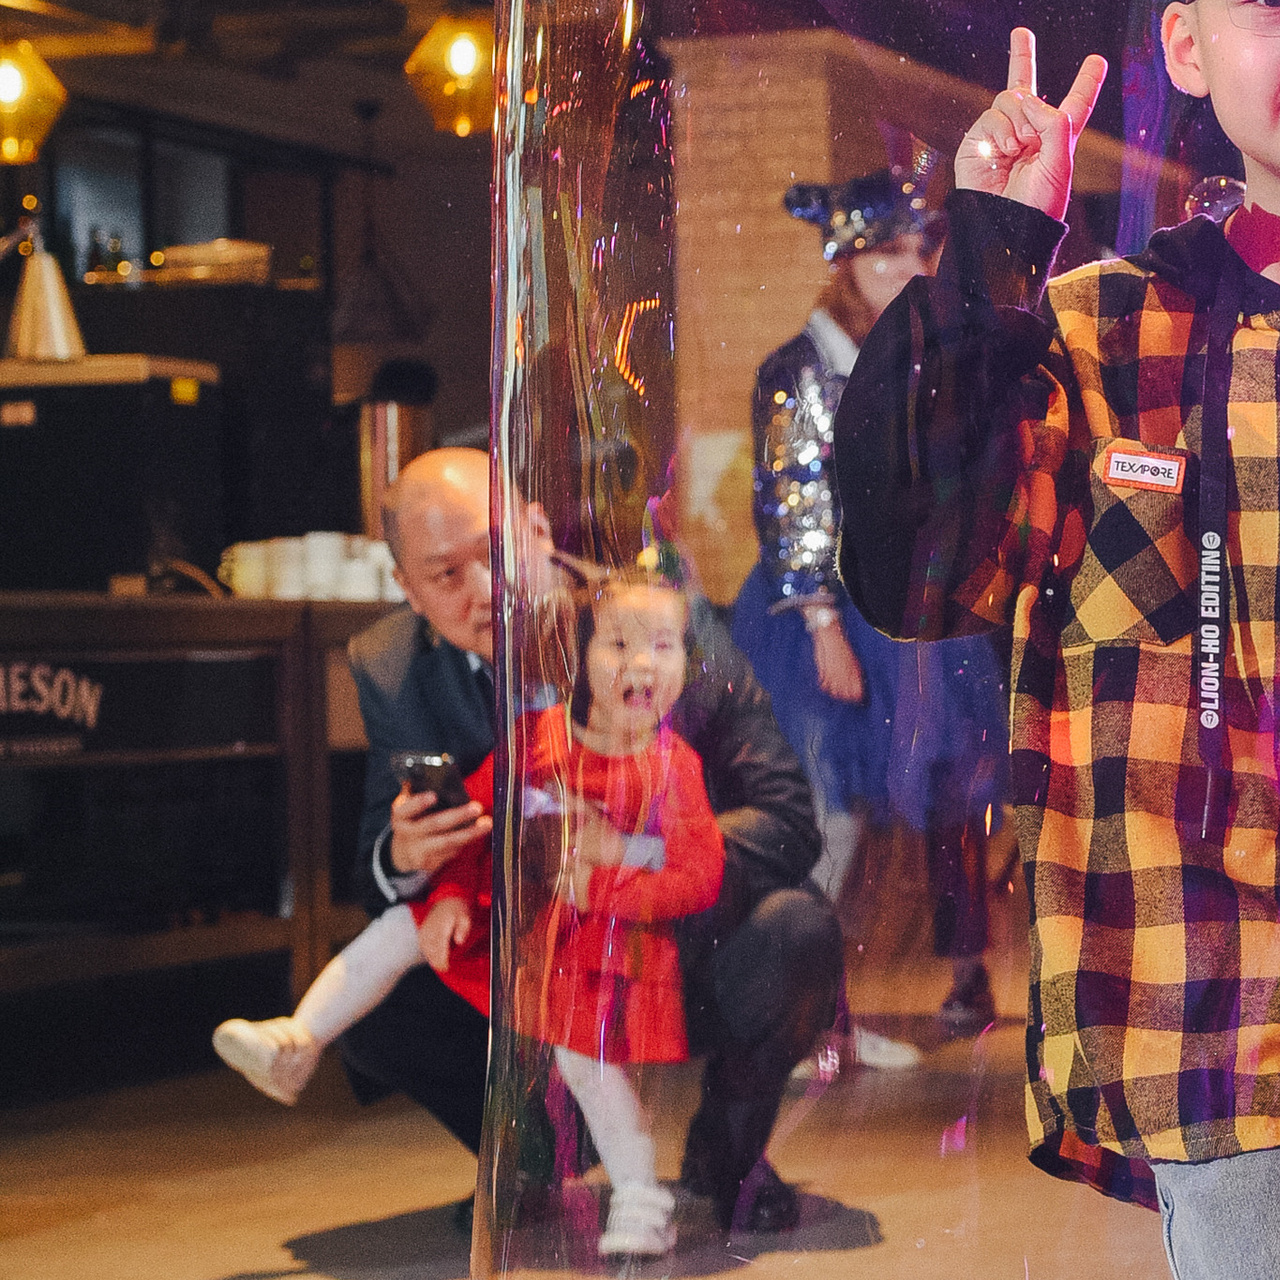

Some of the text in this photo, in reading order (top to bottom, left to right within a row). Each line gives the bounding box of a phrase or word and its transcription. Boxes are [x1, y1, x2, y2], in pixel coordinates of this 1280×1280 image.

[1114, 460, 1175, 479] TEXAPORE
[0, 662, 103, 729] ESON
[1200, 624, 1220, 710] LION-HO
